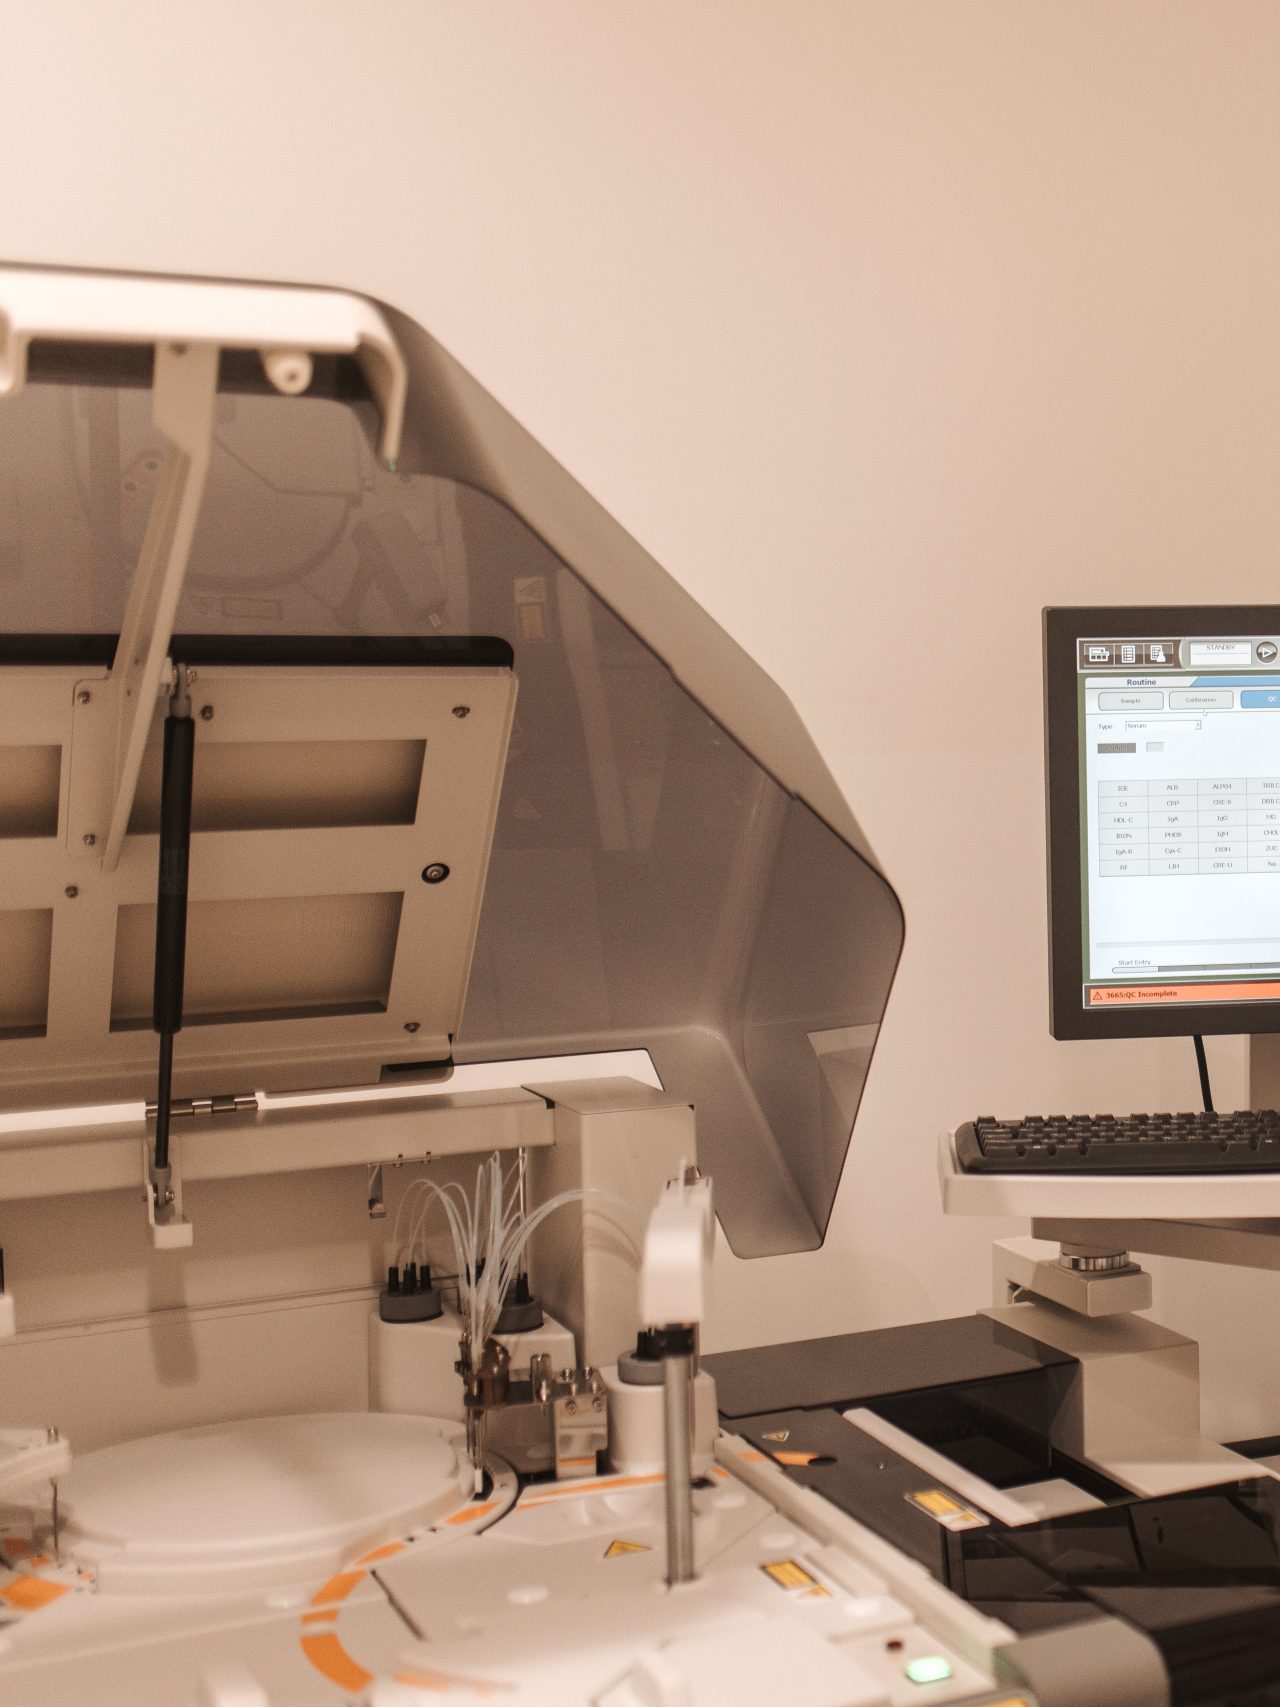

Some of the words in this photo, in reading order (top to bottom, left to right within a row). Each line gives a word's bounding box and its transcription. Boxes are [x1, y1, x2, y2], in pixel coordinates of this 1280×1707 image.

[1206, 644, 1236, 652] STANDBY
[1126, 678, 1157, 687] Routine
[1185, 696, 1217, 704] Calibration
[1267, 695, 1278, 703] QC
[1098, 723, 1113, 731] Type
[1135, 958, 1151, 966] Entry
[1106, 991, 1136, 999] 3665:QC
[1138, 990, 1177, 998] Incomplete
